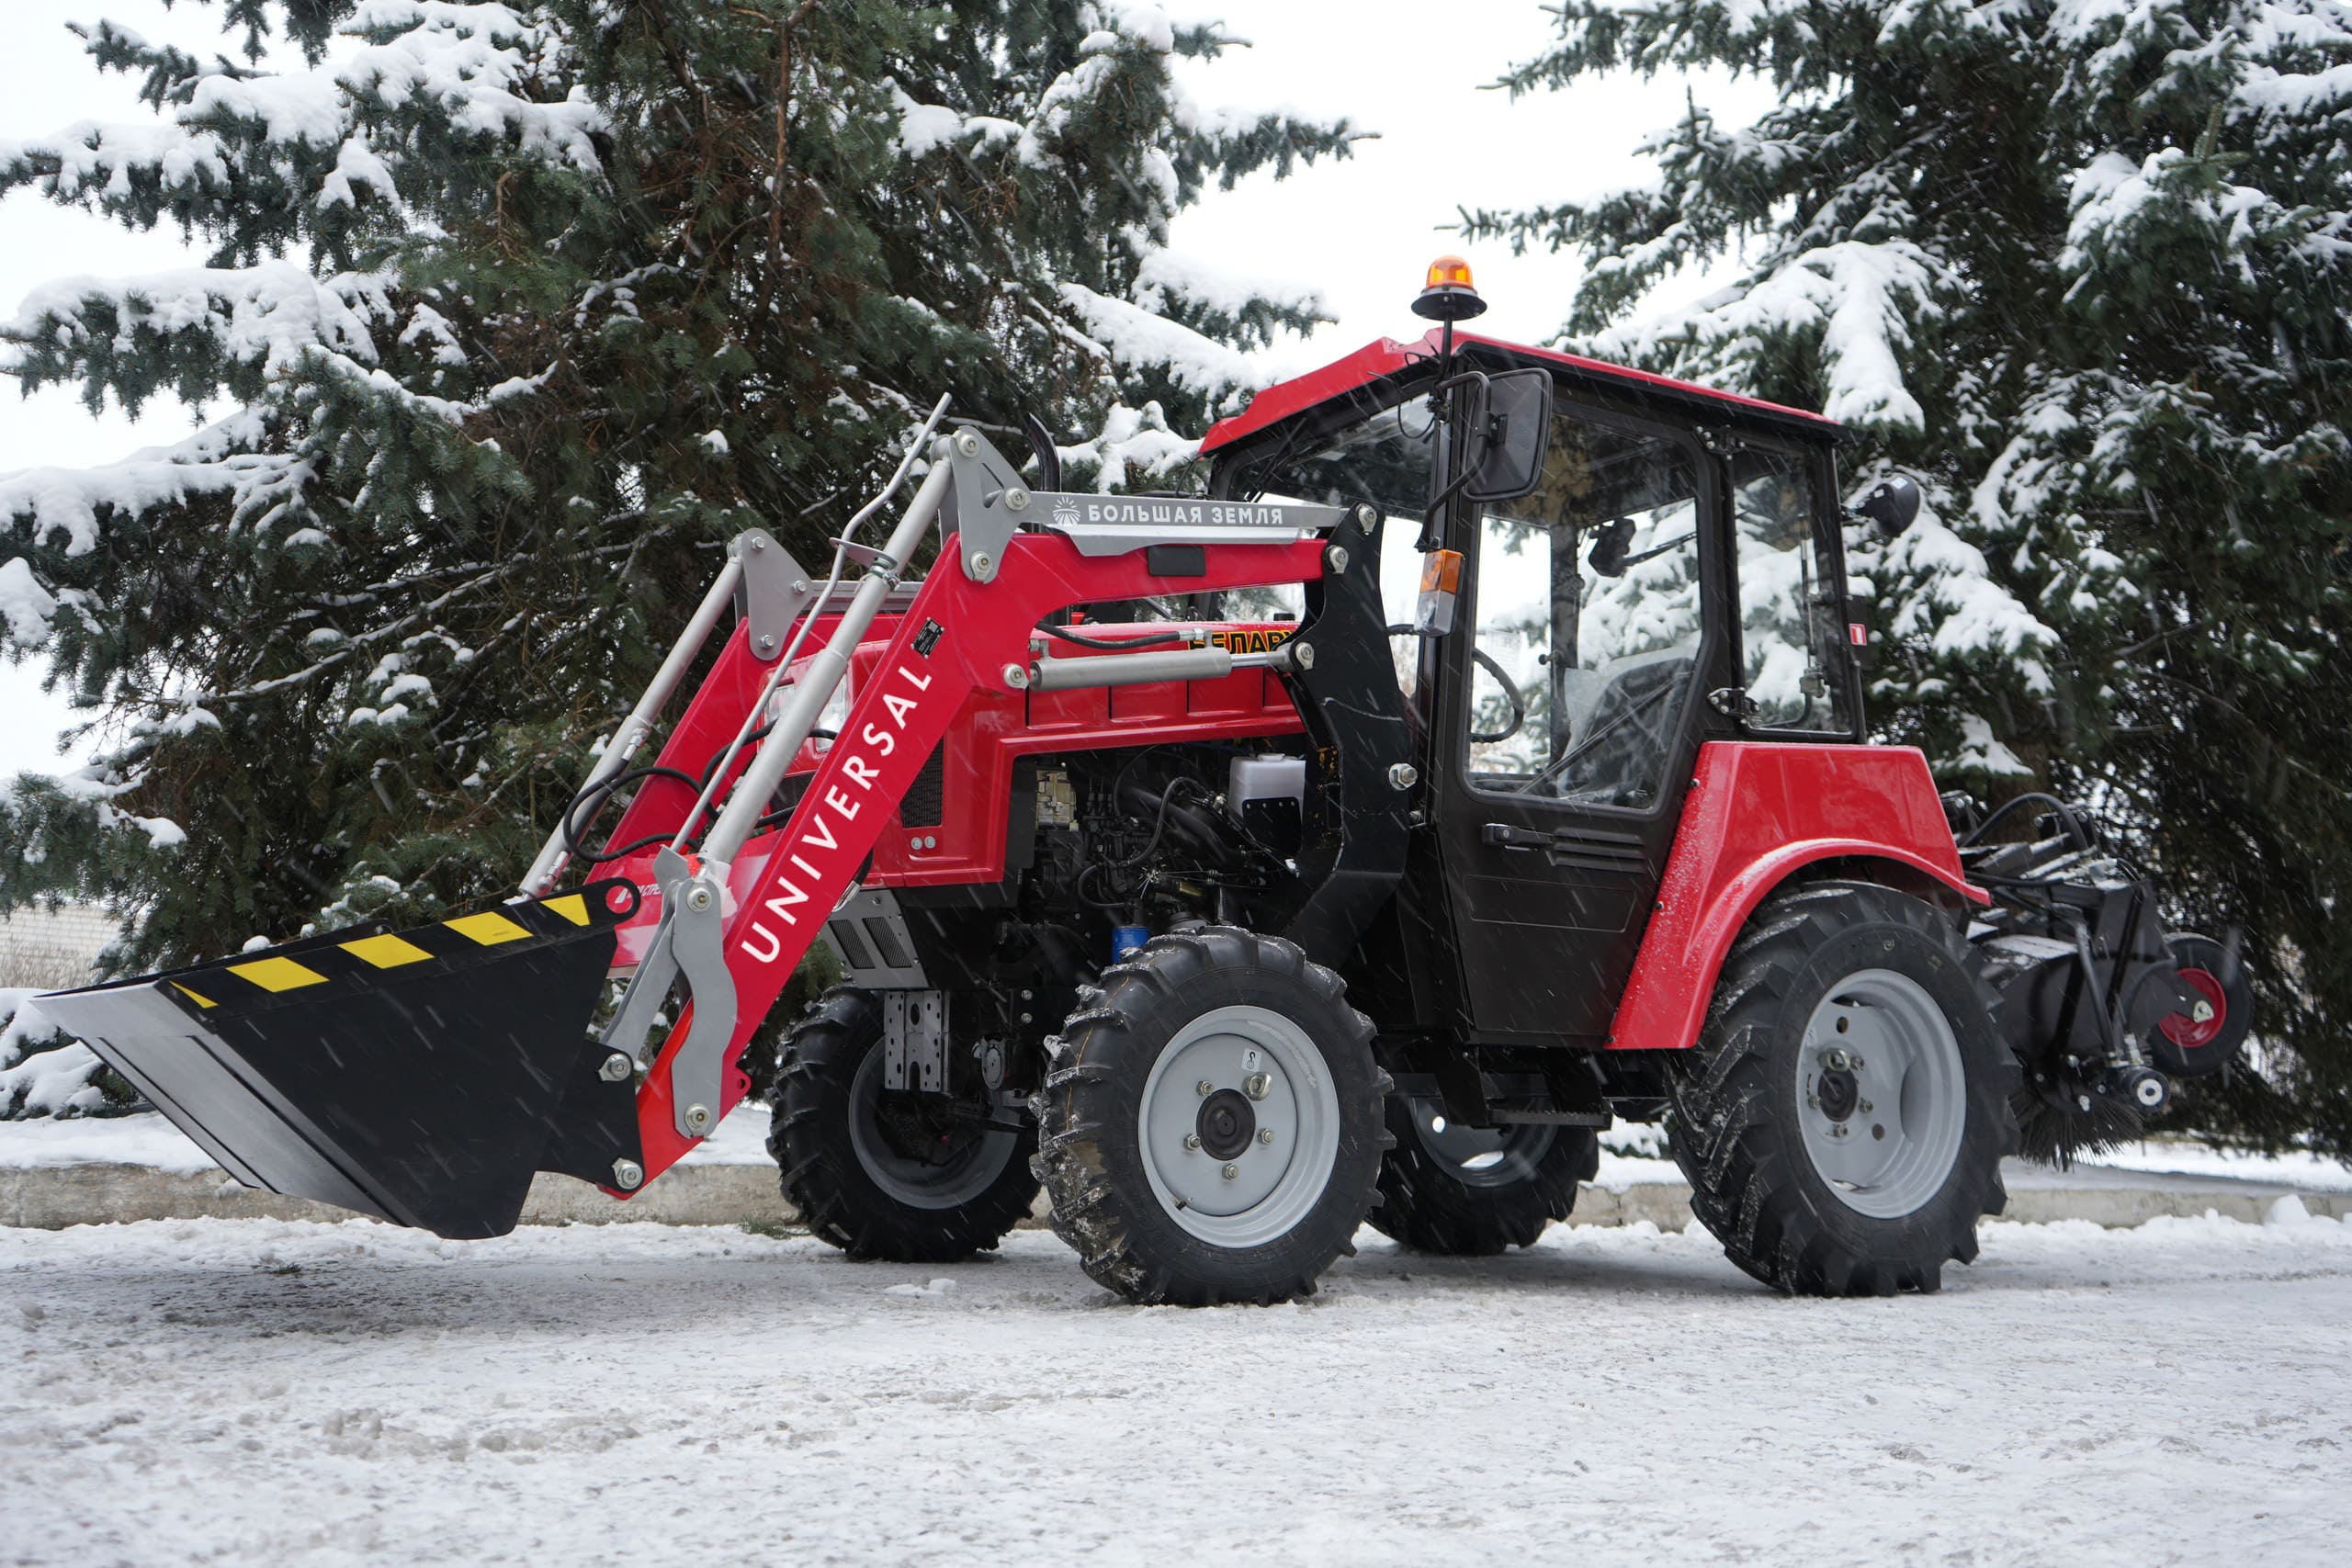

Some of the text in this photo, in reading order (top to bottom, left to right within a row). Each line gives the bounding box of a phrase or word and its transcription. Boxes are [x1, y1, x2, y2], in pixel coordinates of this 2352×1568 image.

[1087, 504, 1283, 525] БОЛЬШАЯ ЗЕМЛЯ
[1188, 629, 1293, 654] БЕЛАР
[741, 666, 933, 964] UNIVERSAL
